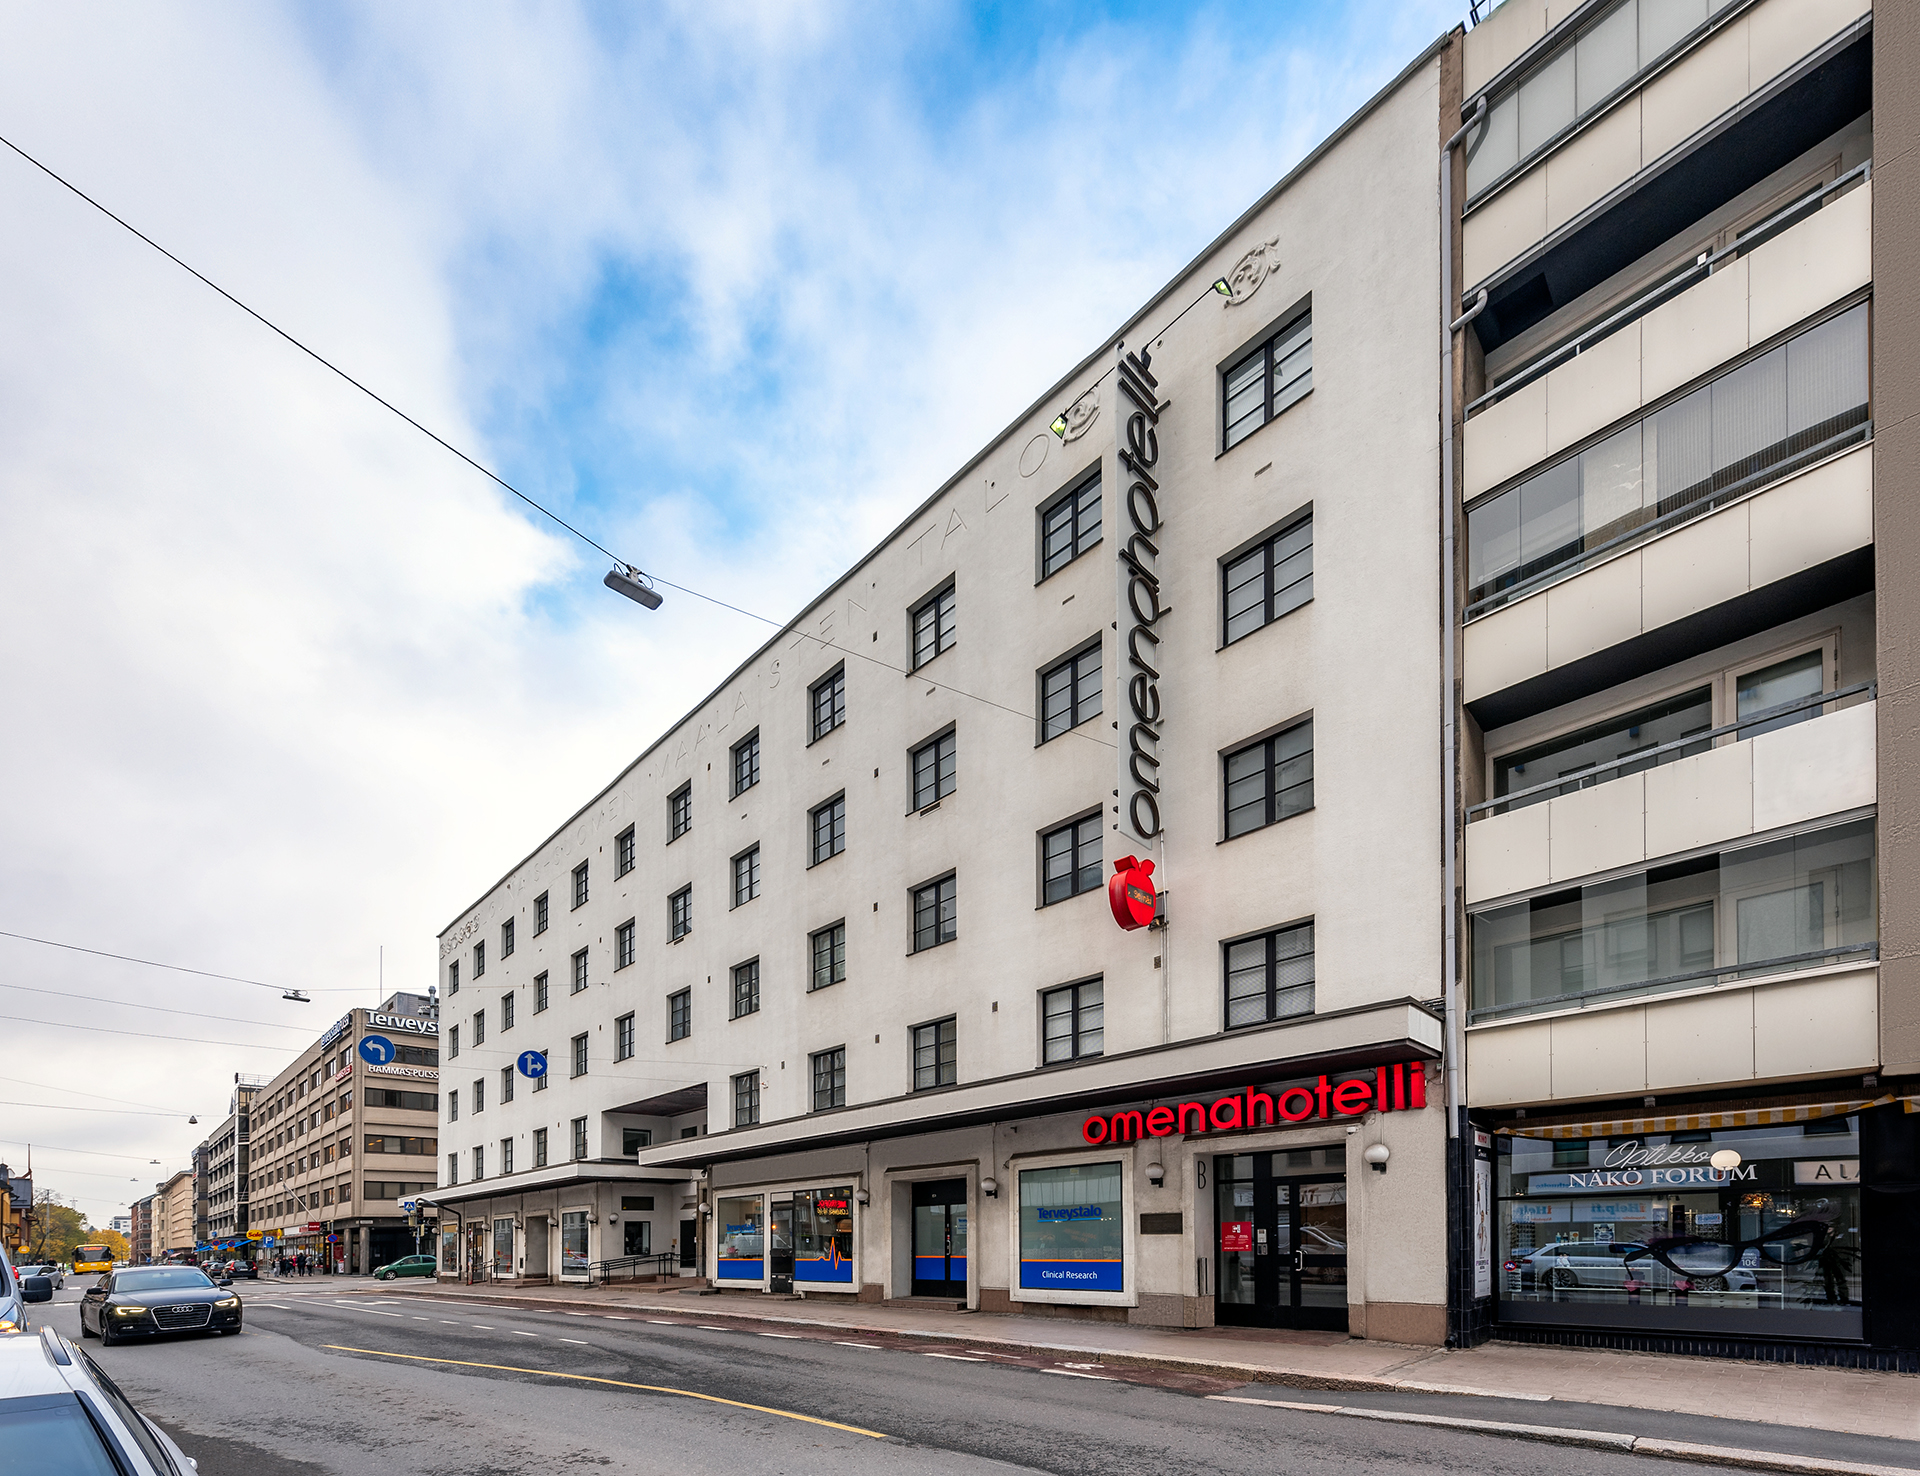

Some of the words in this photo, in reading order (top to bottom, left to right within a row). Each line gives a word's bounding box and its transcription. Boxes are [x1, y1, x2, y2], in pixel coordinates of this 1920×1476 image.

[906, 433, 1050, 566] TALO
[1117, 351, 1161, 839] omenahotelli
[1082, 1061, 1427, 1145] omenahotelli
[1604, 1140, 1711, 1169] Optikko
[1197, 1161, 1206, 1189] B
[1568, 1167, 1643, 1188] NÄKÖ
[1650, 1164, 1758, 1185] FORUM
[1037, 1205, 1102, 1221] Terveystalo
[1042, 1270, 1064, 1279] Clinical
[1066, 1271, 1098, 1279] Research
[1741, 1259, 1757, 1267] 10€
